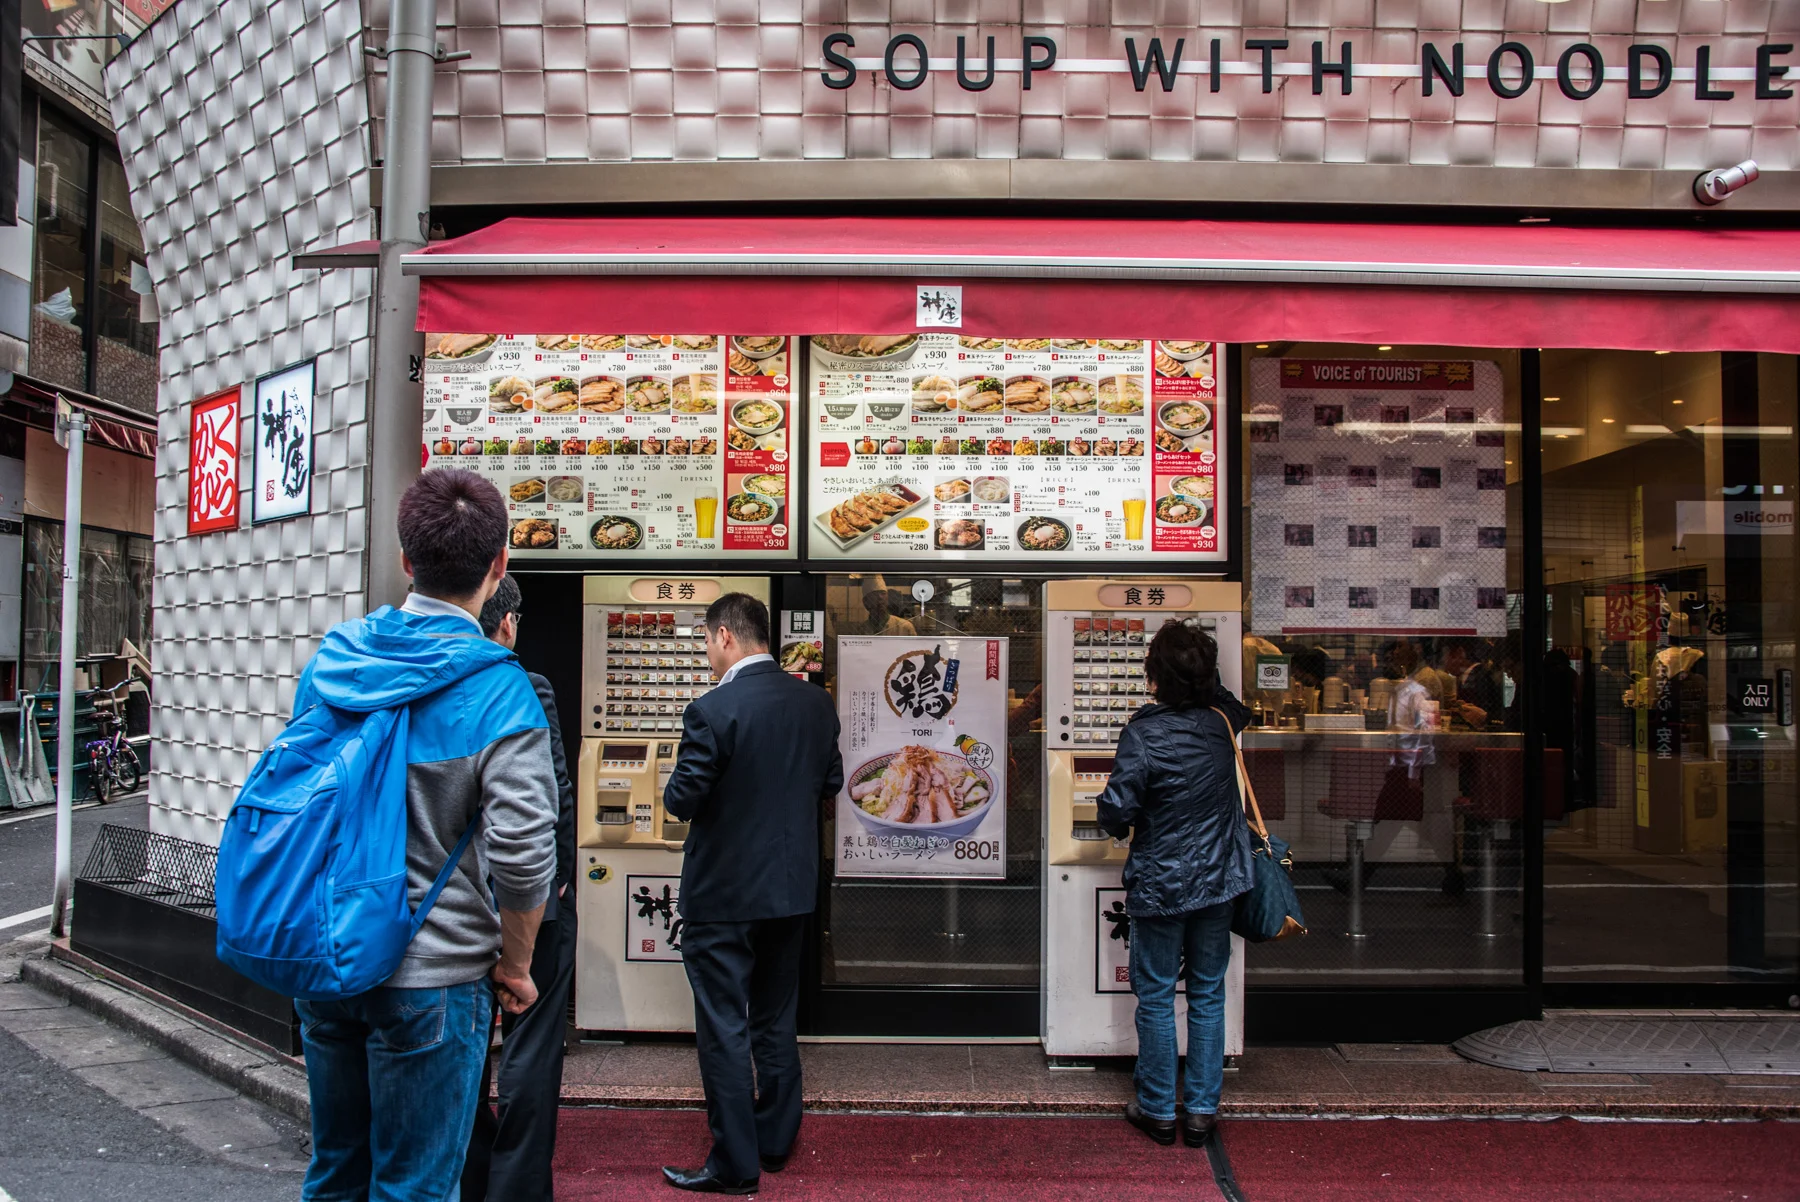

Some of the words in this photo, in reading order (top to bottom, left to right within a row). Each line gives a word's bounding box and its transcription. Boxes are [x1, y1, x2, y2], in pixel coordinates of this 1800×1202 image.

[821, 33, 1057, 91] SOUP
[1125, 38, 1352, 96] WITH
[1422, 41, 1794, 100] NOODLE
[498, 352, 520, 360] ¥930
[925, 351, 947, 359] ¥930
[829, 361, 949, 371] 秘密のスープはやさしいスープ。
[1313, 365, 1350, 382] VOICE
[1354, 365, 1366, 381] of
[1369, 365, 1422, 382] TOURIST
[764, 464, 785, 472] ¥980
[1192, 465, 1213, 473] ¥980
[763, 539, 785, 547] ¥930
[1192, 540, 1214, 549] ¥930
[656, 582, 696, 600] 食券
[1124, 587, 1165, 606] 食券
[988, 642, 997, 676] 期間限定
[1744, 684, 1768, 696] 入口
[1742, 696, 1770, 707] ONLY
[911, 728, 933, 737] TORI
[842, 836, 949, 849] 蒸し鶏と白髪ねぎの
[843, 849, 937, 860] おいしいラーメン
[954, 840, 992, 860] 880
[631, 884, 683, 952] 神
